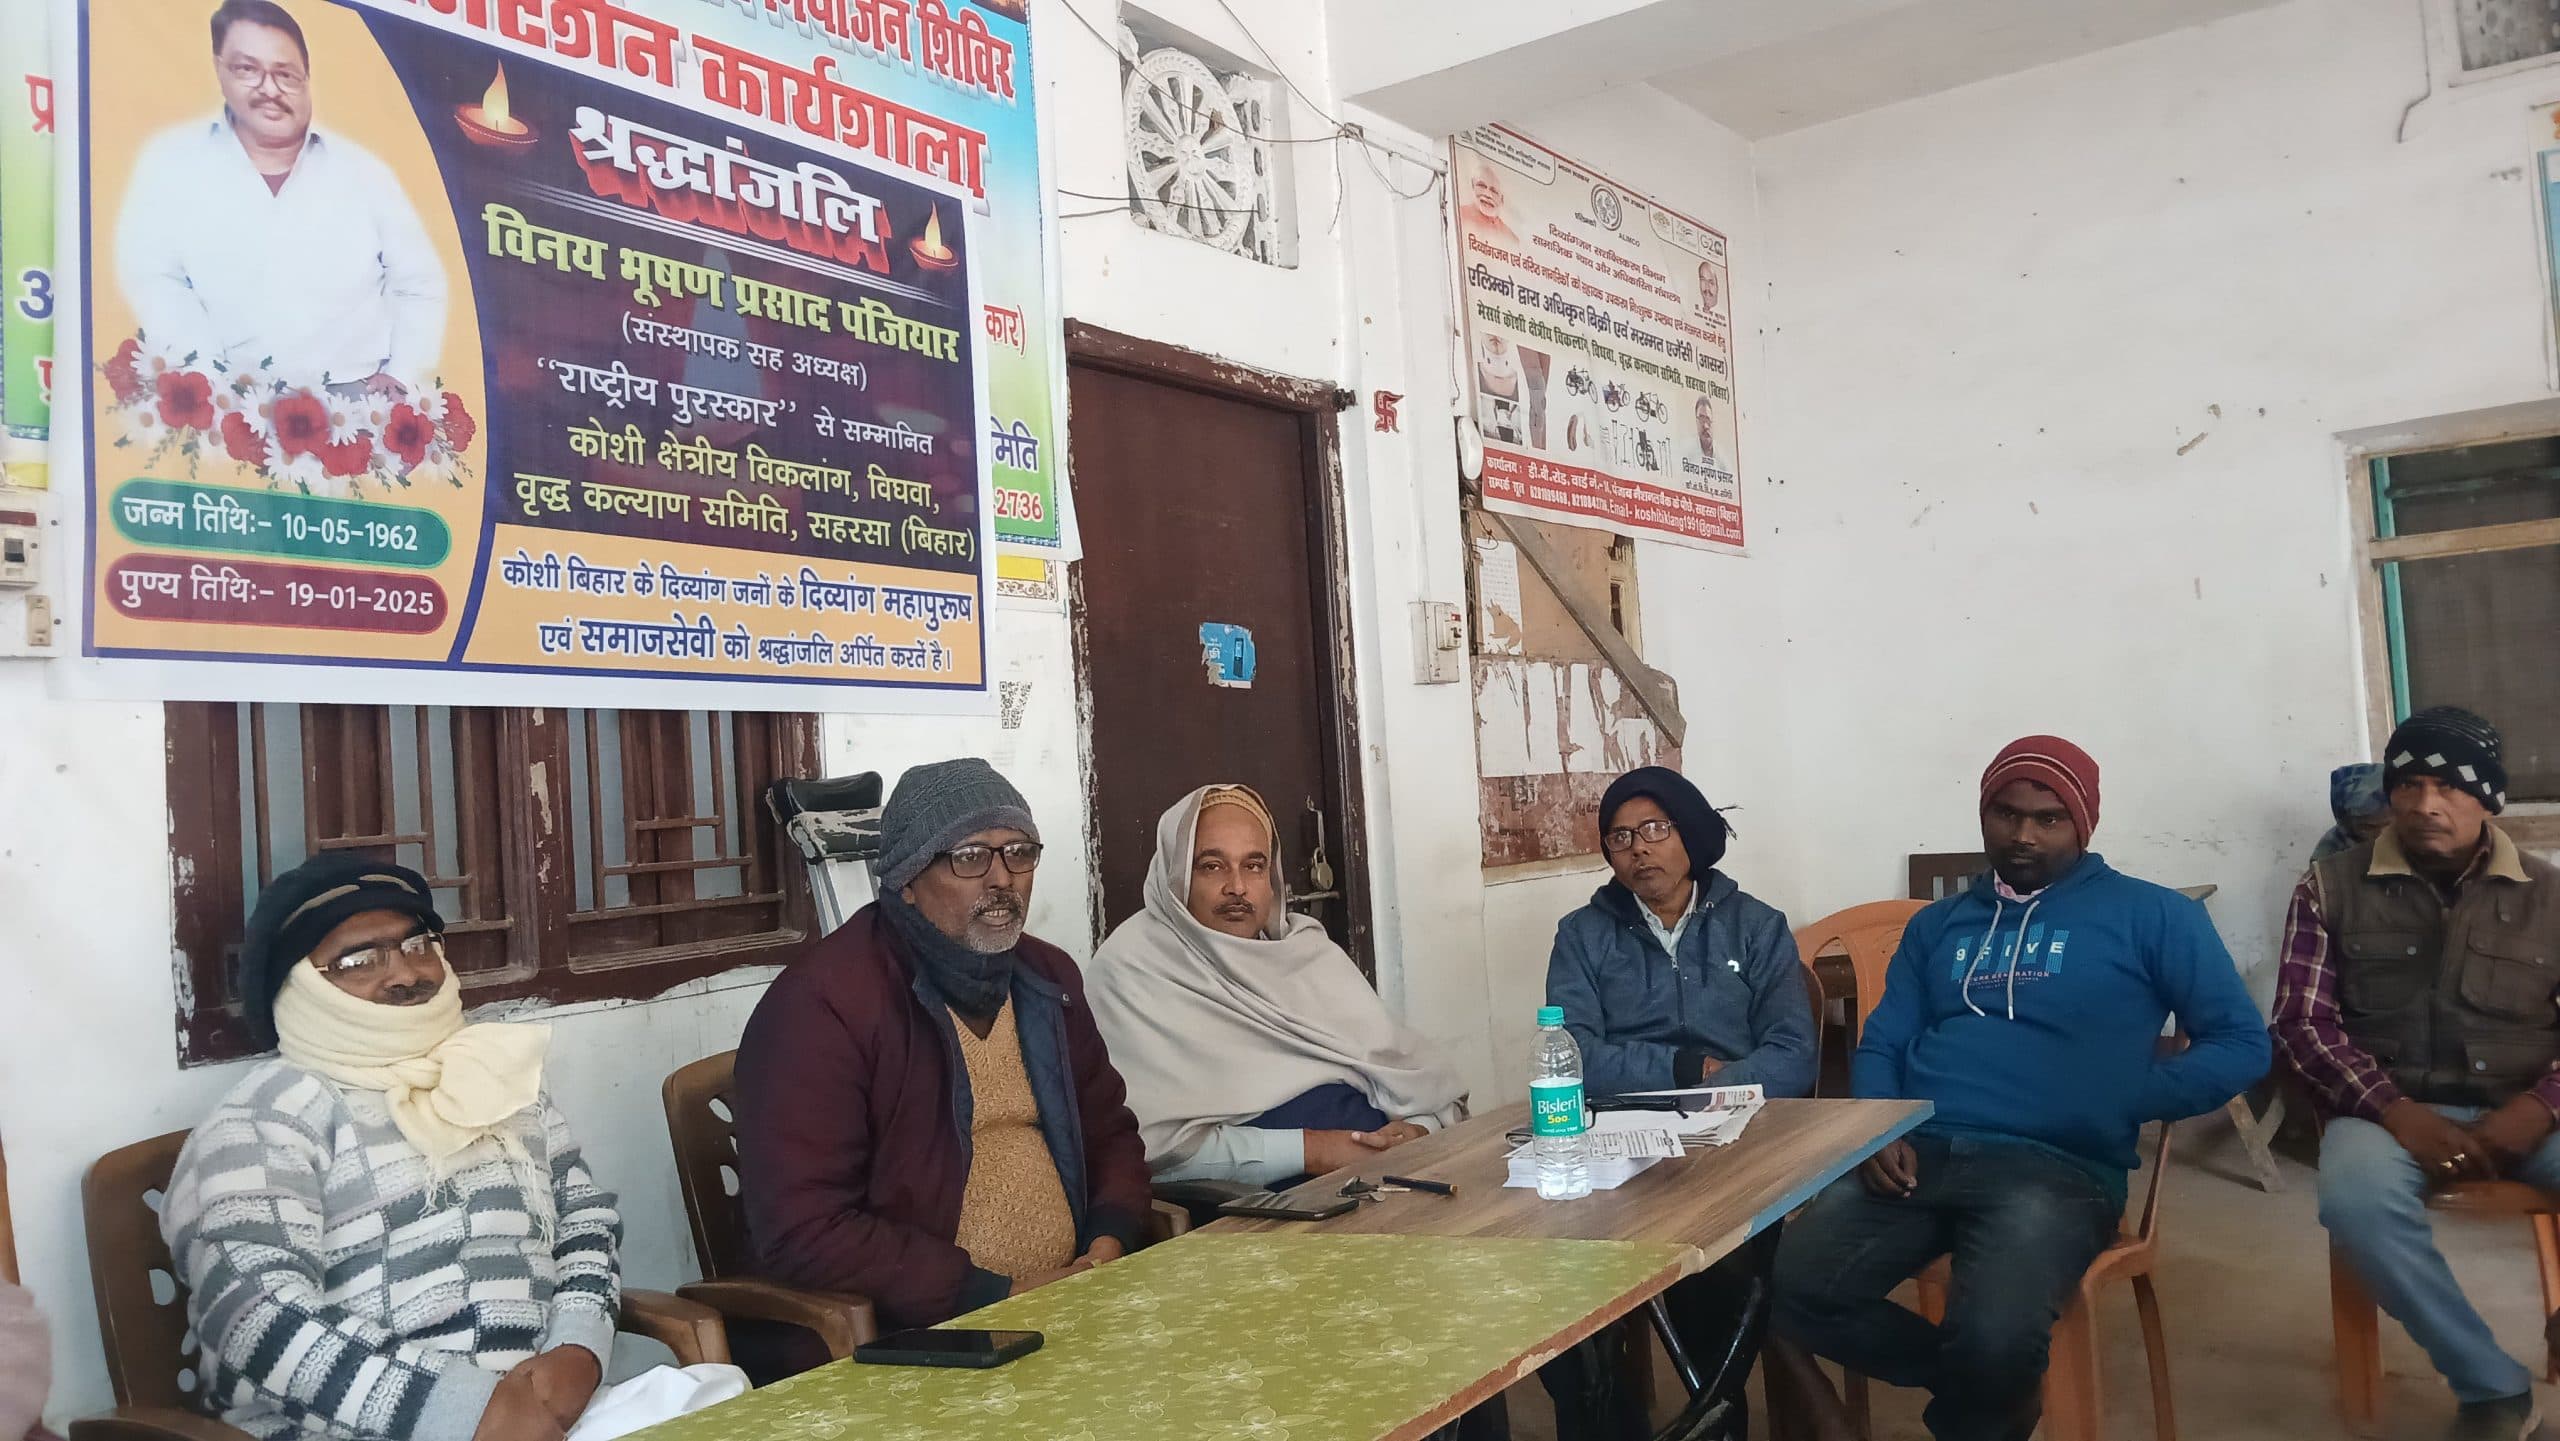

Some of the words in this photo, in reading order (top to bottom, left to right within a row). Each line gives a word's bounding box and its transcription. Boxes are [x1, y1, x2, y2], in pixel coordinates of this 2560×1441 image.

[916, 0, 1014, 98] शिविर
[692, 34, 987, 199] कार्यशाला
[568, 105, 884, 243] श्रद्धांजलि
[480, 202, 608, 281] विनय
[619, 246, 727, 309] भूषण
[731, 273, 831, 333] प्रसाद
[622, 310, 739, 360] (संस्थापक
[746, 341, 784, 371] सह
[792, 351, 867, 391] अध्यक्ष)
[984, 304, 1025, 357] कार)
[1517, 284, 1541, 308] द्वारा
[1543, 292, 1586, 327] अधिकृत
[1630, 327, 1664, 353] मरम्मत
[567, 416, 646, 465] कोशी
[658, 430, 737, 479] क्षेत्रीय
[746, 444, 859, 503] विकलांग,
[813, 406, 835, 437] से
[841, 421, 933, 455] सम्मानित
[122, 496, 185, 530] जन्म
[281, 511, 418, 551] 10-05-1962
[513, 472, 571, 516] वृद्ध
[581, 481, 690, 522] कल्याण
[700, 489, 798, 541] समिति,
[807, 511, 891, 547] सहरसा
[901, 515, 975, 562] (बिहार)
[995, 489, 1043, 521] 2736
[118, 569, 181, 608] पुण्य
[285, 581, 434, 615] 19-01-2025
[503, 550, 560, 589] कोशी
[568, 555, 626, 594] बिहार
[633, 562, 654, 595] के
[660, 564, 726, 601] दिव्यांग
[732, 573, 771, 606] जनों
[777, 576, 796, 607] के
[799, 567, 875, 613] दिव्यांग
[540, 617, 573, 652] एवं
[579, 612, 716, 658] समाजसेवी
[722, 625, 750, 660] को
[758, 633, 833, 665] श्रद्धांजलि
[840, 635, 885, 667] अर्पित
[1537, 1095, 1577, 1115] Bisleri
